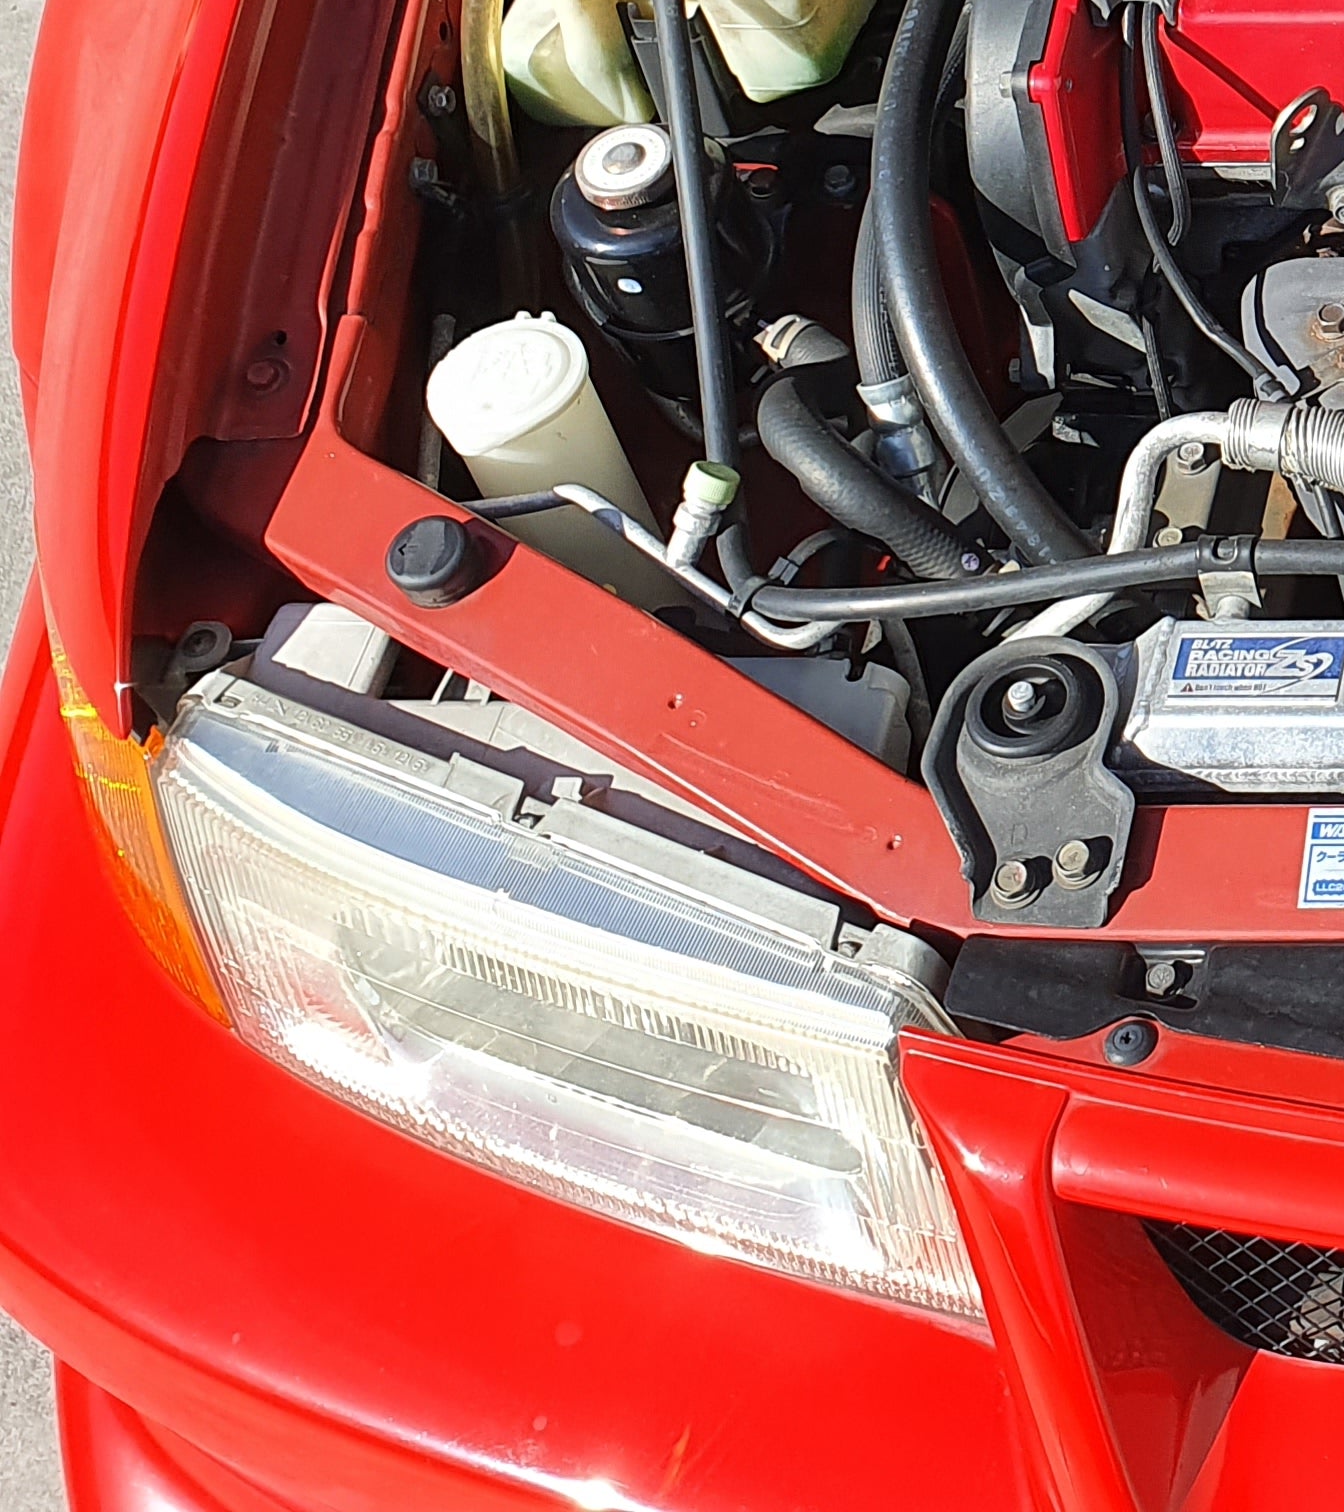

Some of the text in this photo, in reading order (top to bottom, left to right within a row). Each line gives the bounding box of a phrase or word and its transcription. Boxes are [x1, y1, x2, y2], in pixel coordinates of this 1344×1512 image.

[1191, 639, 1234, 649] BLITZ
[1189, 649, 1271, 661] RACING
[1185, 663, 1267, 677] RADIATOR
